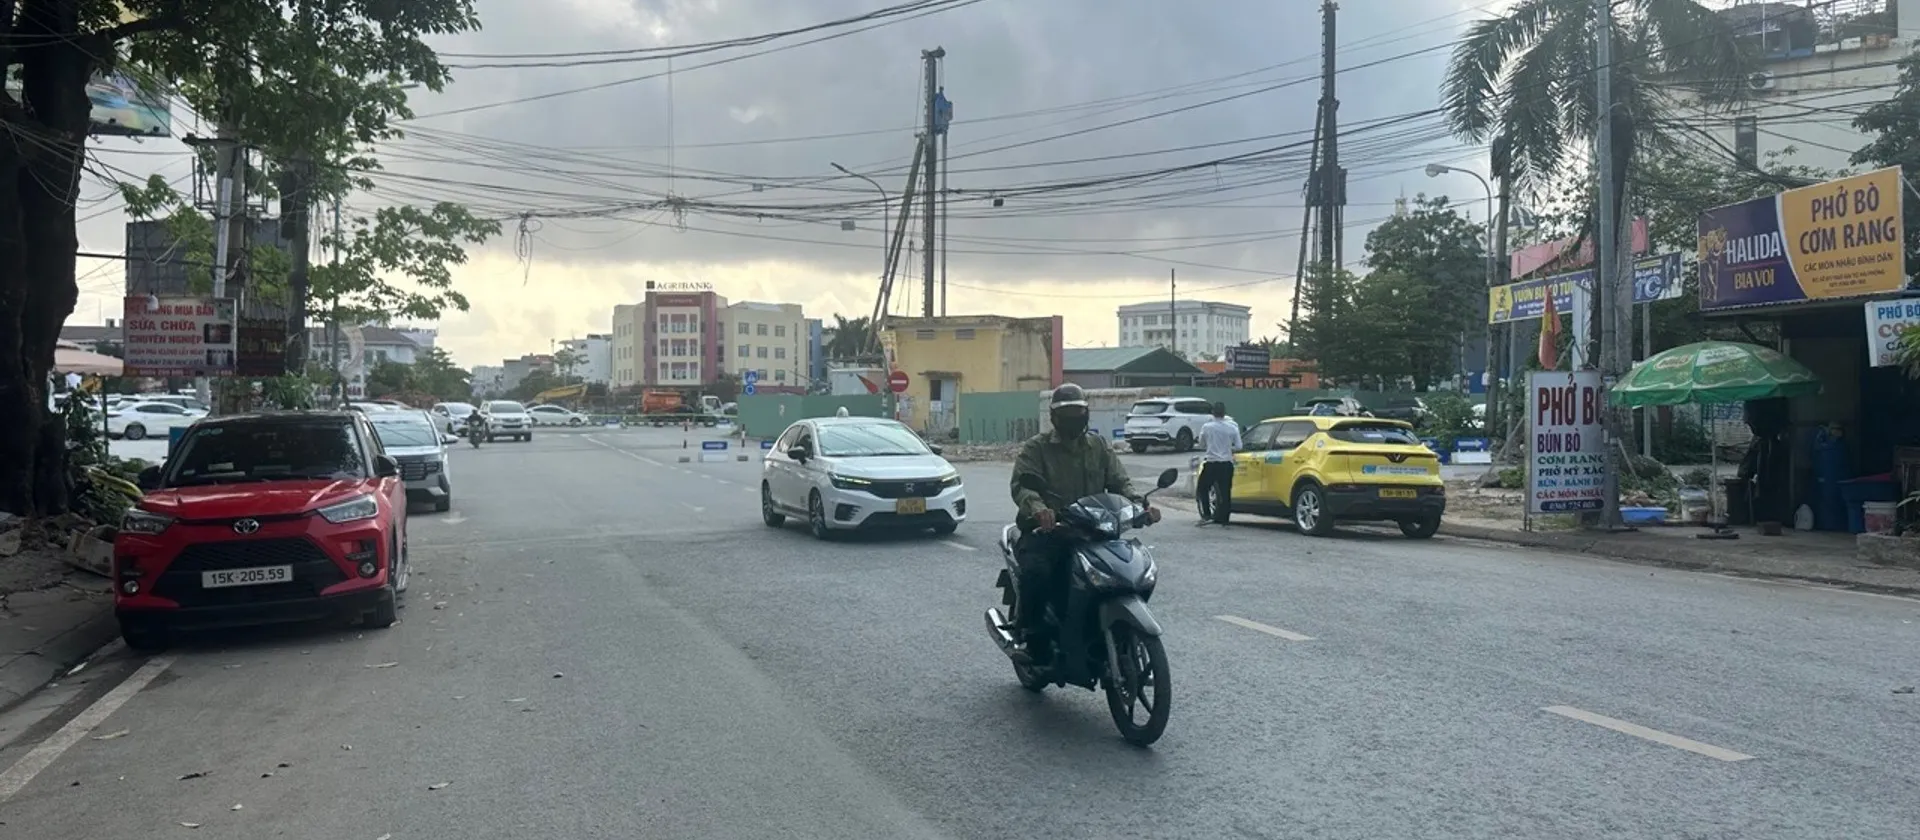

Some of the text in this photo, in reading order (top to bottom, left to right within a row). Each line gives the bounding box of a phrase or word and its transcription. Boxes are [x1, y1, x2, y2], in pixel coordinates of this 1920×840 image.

[1811, 182, 1880, 222] PHỞ BÒ
[1726, 231, 1782, 264] HALIDA
[1800, 216, 1896, 255] CƠM RANG
[657, 282, 712, 290] AGRIBANK
[1734, 271, 1754, 290] BIA
[1538, 373, 1577, 426] PHỞ
[1537, 428, 1581, 453] BÚN BÒ
[211, 568, 285, 584] 15K-205.59
